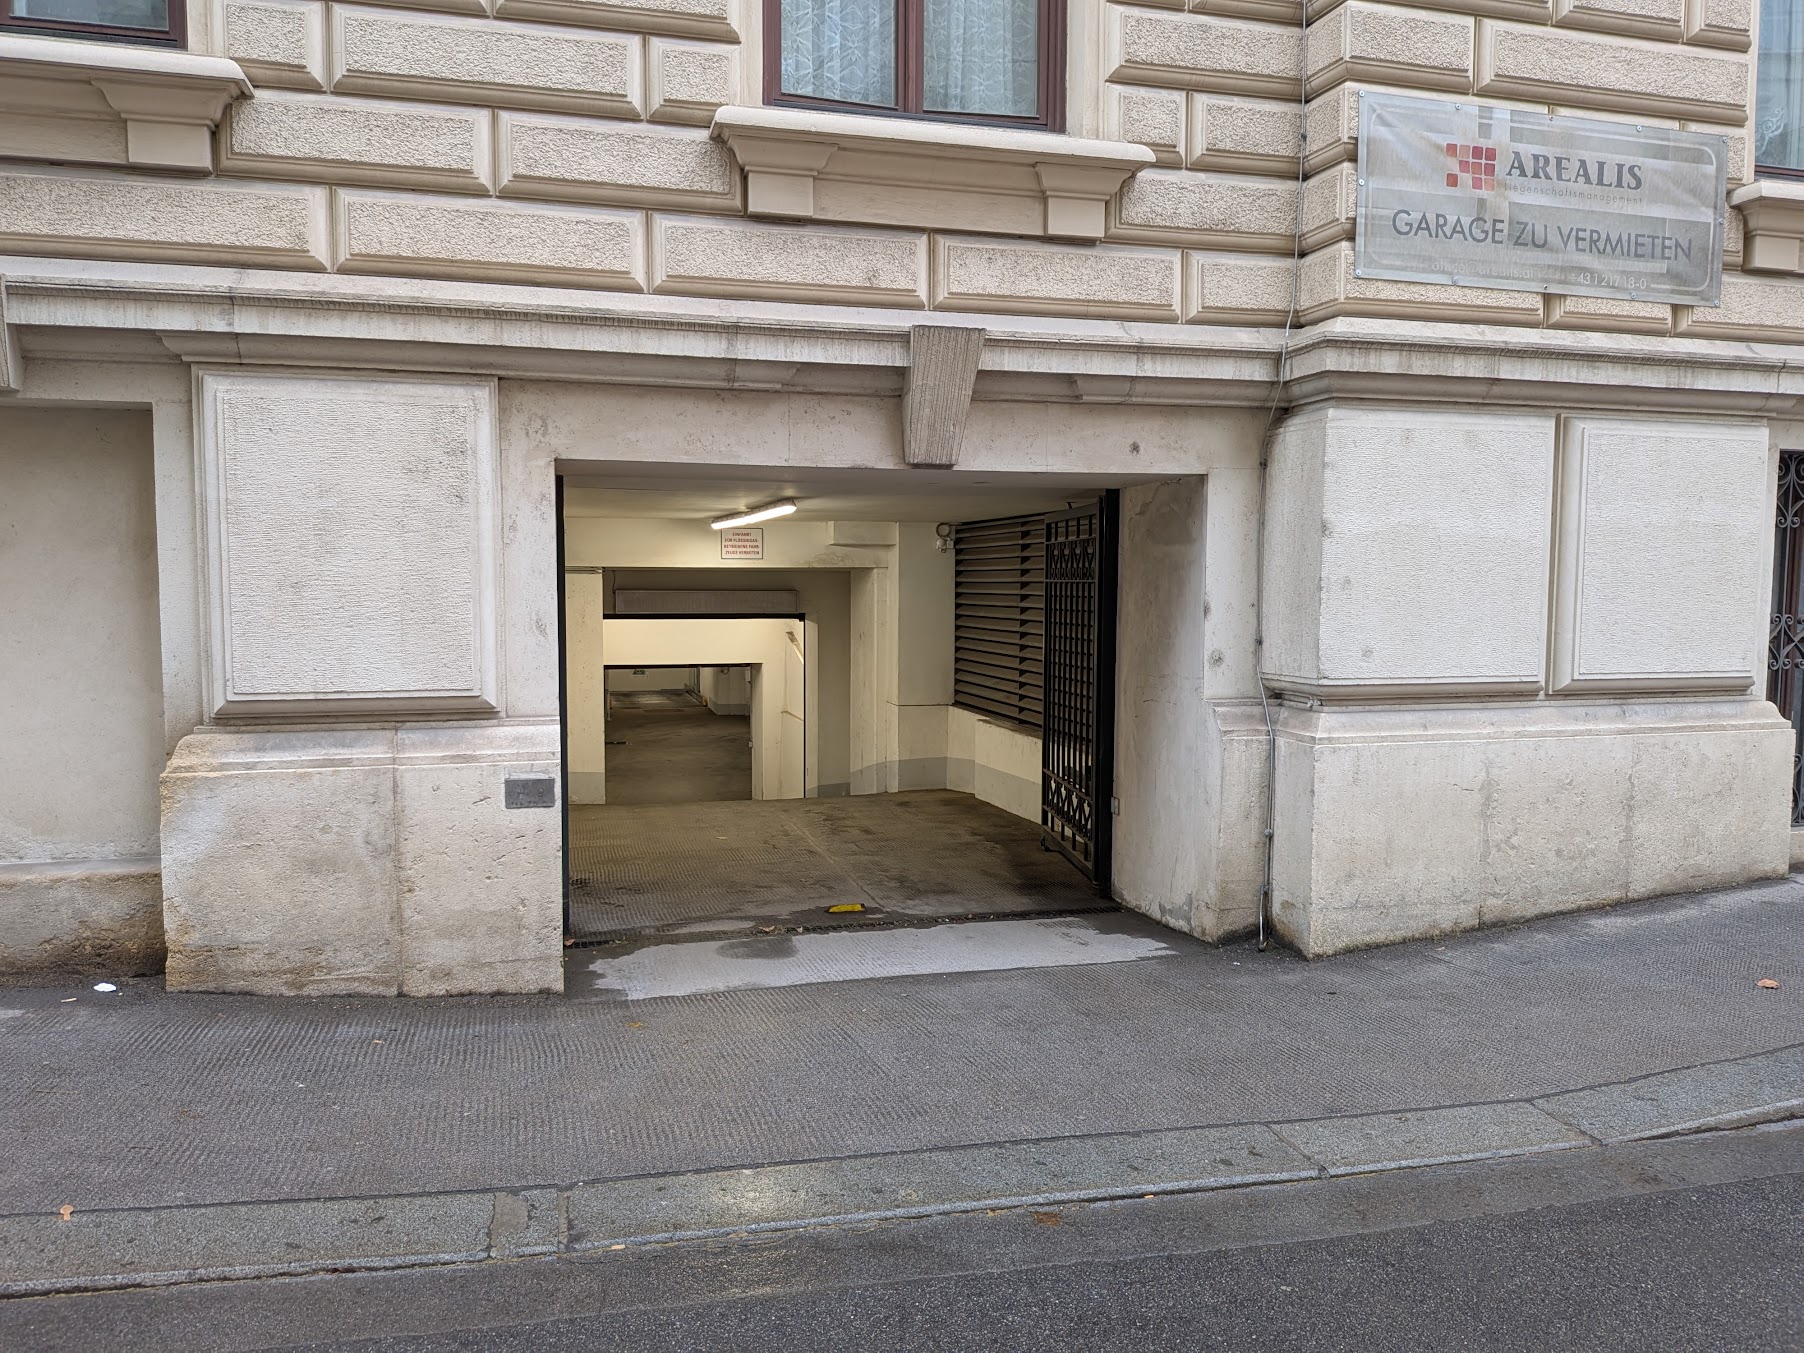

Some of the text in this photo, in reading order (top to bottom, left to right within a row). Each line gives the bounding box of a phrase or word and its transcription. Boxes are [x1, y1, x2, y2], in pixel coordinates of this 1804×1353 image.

[1505, 151, 1643, 190] AREALIS
[1392, 209, 1692, 262] GARAGE ZU VERMIETEN
[1569, 272, 1591, 285] +43
